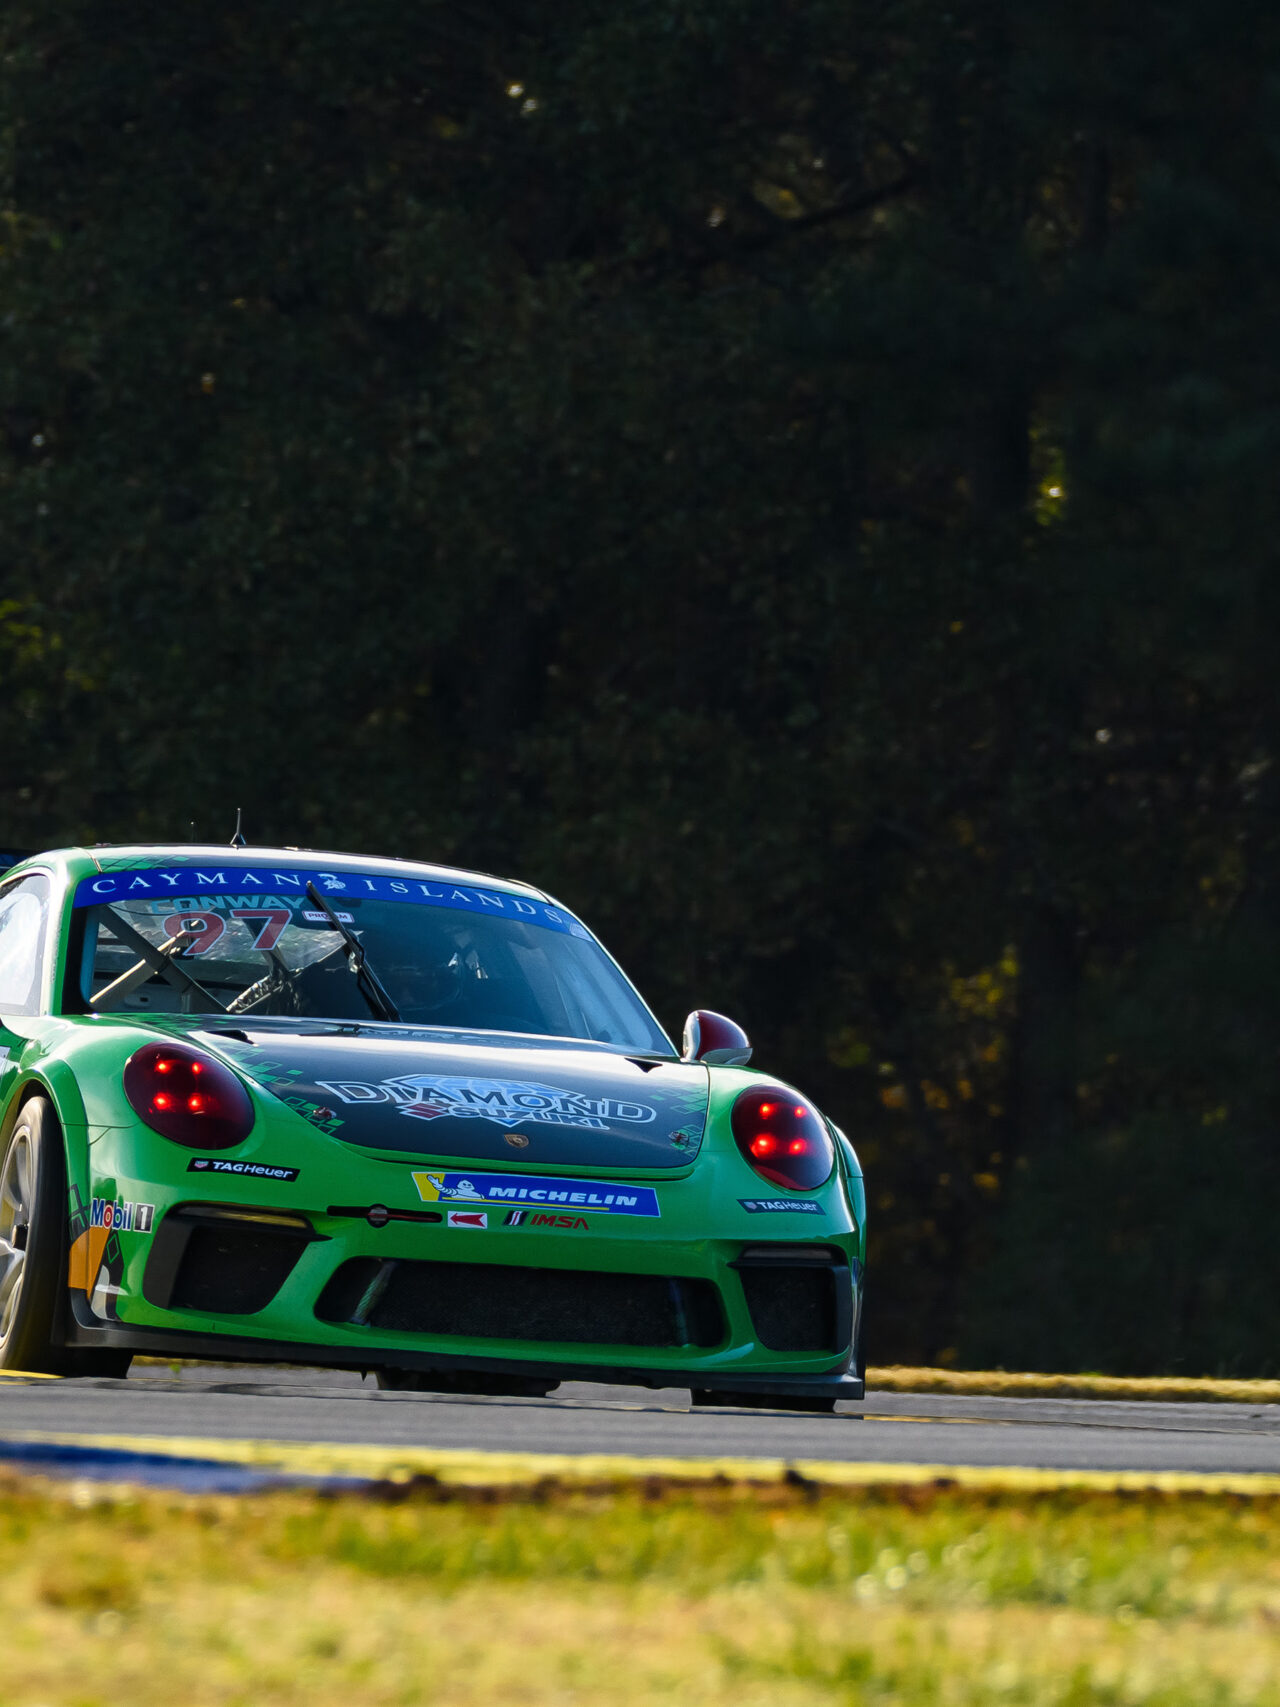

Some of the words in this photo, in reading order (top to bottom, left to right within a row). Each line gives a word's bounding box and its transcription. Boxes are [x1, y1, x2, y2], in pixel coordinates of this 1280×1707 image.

[90, 872, 301, 893] CAYMAN
[363, 879, 563, 924] ISLANDS
[151, 895, 308, 914] CONWAY
[163, 909, 293, 956] 97
[315, 1081, 656, 1123] DIAMOND
[447, 1105, 610, 1130] SUZUKI
[488, 1187, 638, 1206] MICHELIN
[90, 1198, 133, 1231] Mobil
[530, 1214, 589, 1231] IMSA
